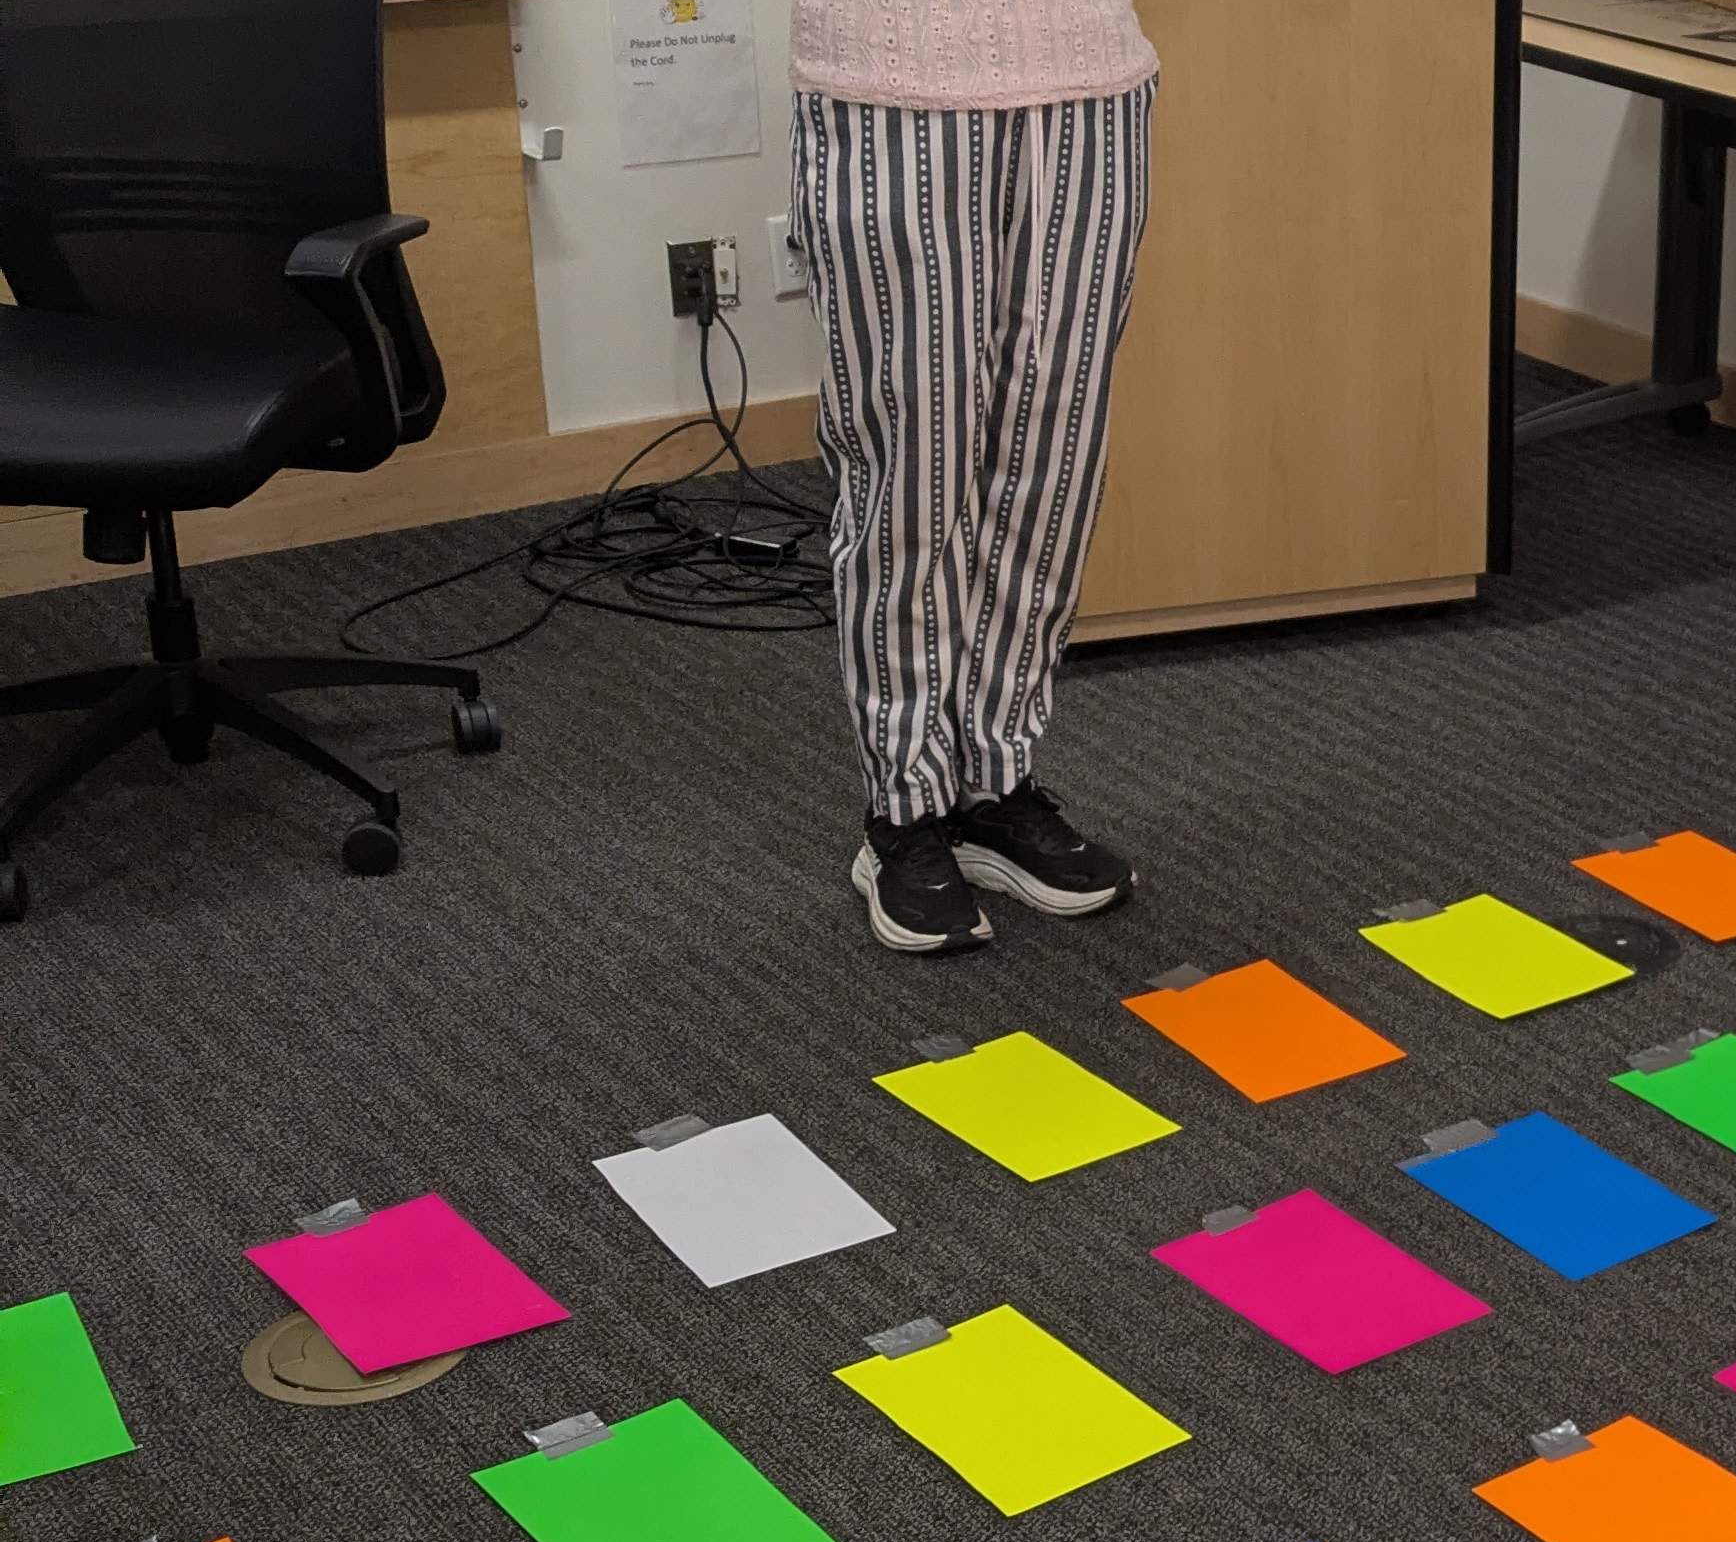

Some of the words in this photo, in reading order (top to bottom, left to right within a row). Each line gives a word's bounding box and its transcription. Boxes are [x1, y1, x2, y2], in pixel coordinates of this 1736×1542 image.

[630, 38, 662, 49] Please
[664, 36, 678, 47] Do
[680, 35, 698, 46] Not
[701, 33, 736, 45] Unplug
[629, 57, 648, 67] the
